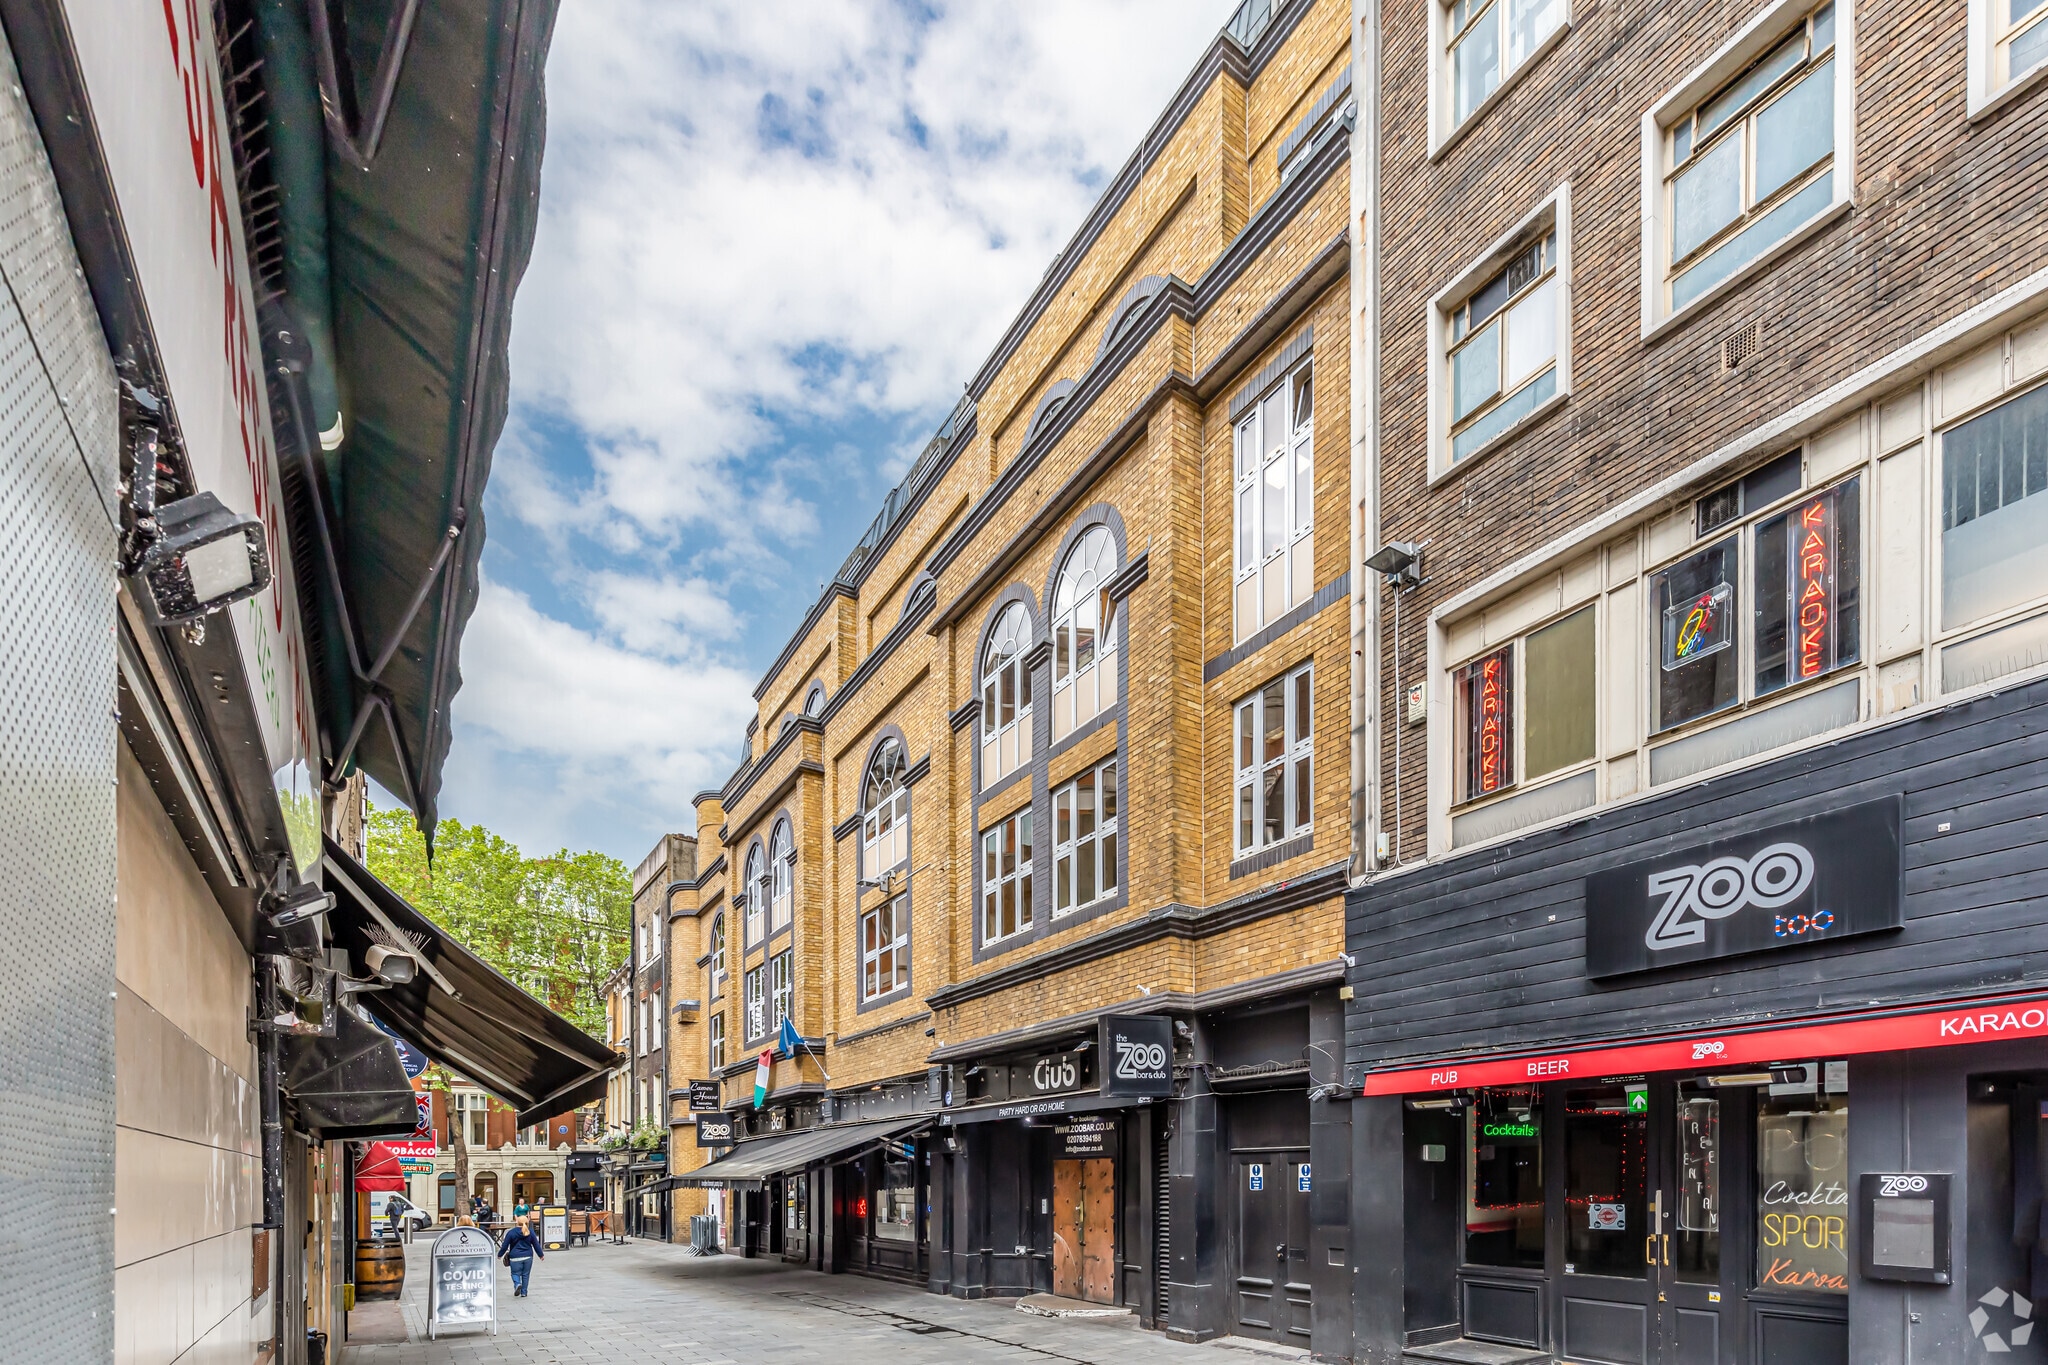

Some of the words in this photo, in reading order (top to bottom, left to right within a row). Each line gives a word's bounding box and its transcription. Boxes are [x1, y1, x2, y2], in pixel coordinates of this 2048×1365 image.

[1800, 501, 1826, 678] KARAOKE
[1482, 657, 1498, 792] KARAOKE
[1774, 909, 1835, 937] too
[1940, 1009, 2048, 1037] KARAO
[1115, 1033, 1128, 1042] the
[1431, 1070, 1458, 1086] PUB
[1527, 1059, 1569, 1077] BEER
[692, 1091, 718, 1101] House
[998, 1107, 1015, 1117] PARTY
[1014, 1105, 1029, 1115] HARD
[1030, 1105, 1038, 1113] OR
[1039, 1103, 1048, 1112] GO
[1048, 1101, 1065, 1111] HOME
[1483, 1123, 1535, 1137] Cocktails
[442, 1269, 486, 1281] COVID
[445, 1281, 484, 1291] TESTING
[452, 1291, 477, 1300] HERE
